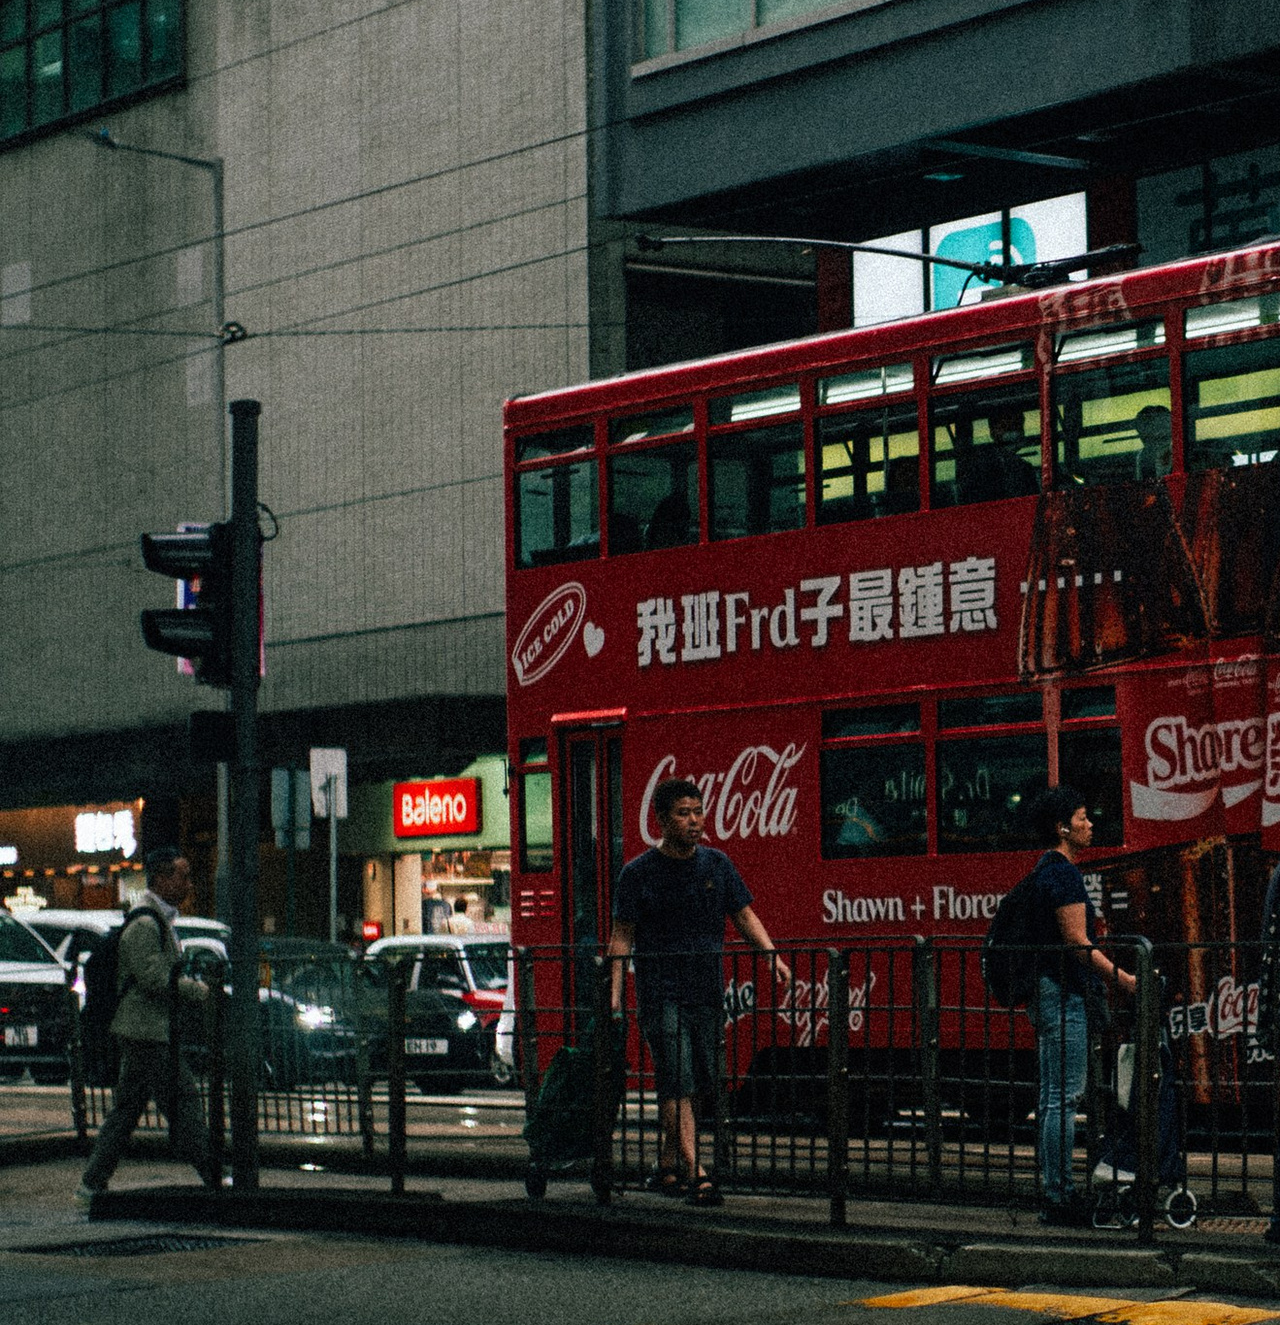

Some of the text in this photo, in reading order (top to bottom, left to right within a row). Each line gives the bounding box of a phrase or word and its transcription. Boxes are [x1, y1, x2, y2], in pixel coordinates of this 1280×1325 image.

[520, 598, 576, 670] ICE COLD
[1148, 717, 1266, 785] Share
[401, 786, 468, 827] Baleno
[638, 741, 807, 847] Ca-Cola
[821, 888, 906, 925] Shawn
